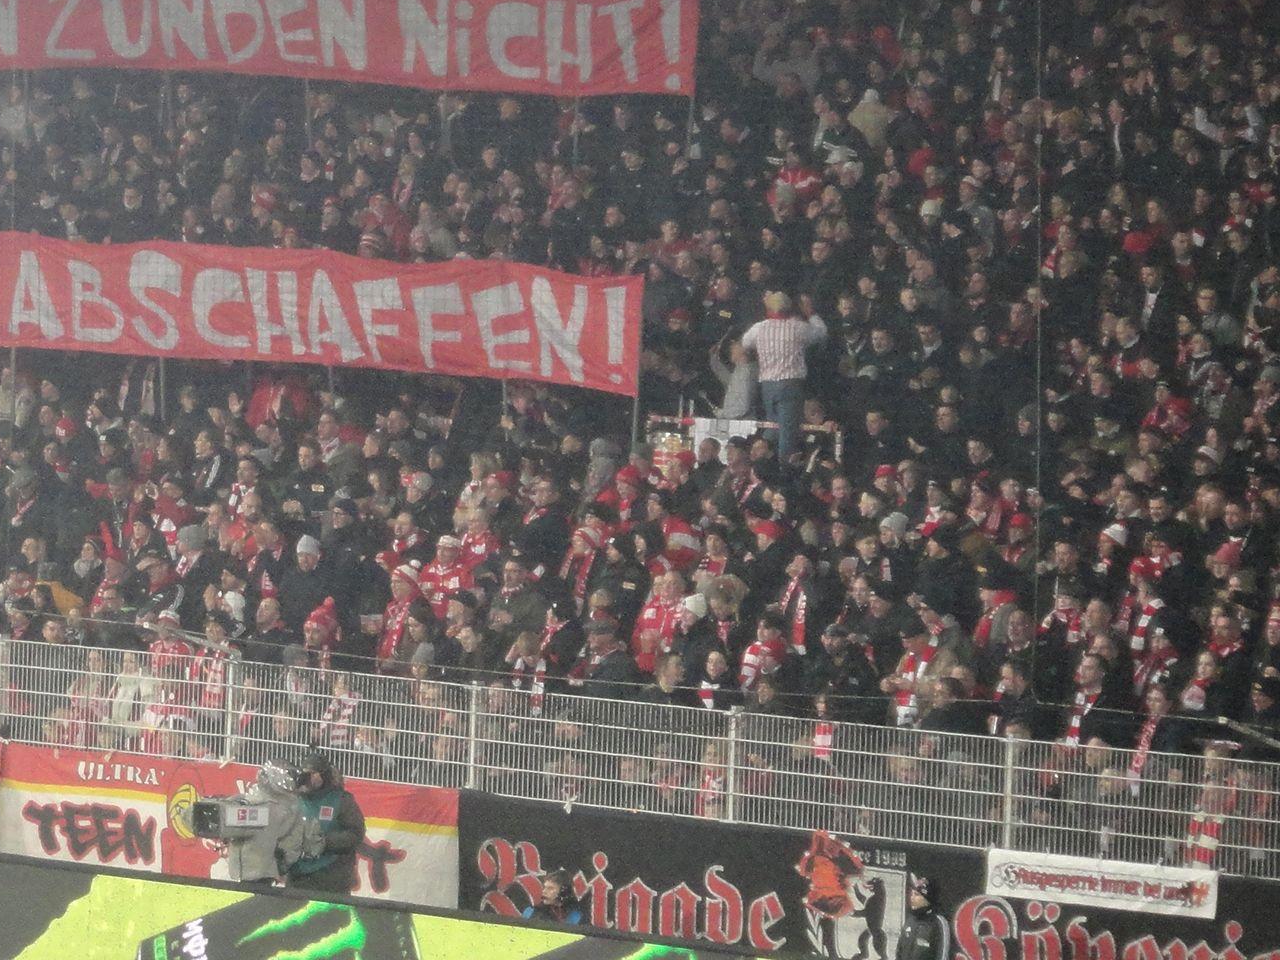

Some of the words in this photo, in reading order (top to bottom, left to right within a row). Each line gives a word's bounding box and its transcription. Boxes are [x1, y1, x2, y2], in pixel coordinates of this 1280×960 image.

[9, 249, 629, 384] ABSCHAFFEN!
[22, 799, 158, 866] TEEN
[477, 837, 787, 952] Bigade
